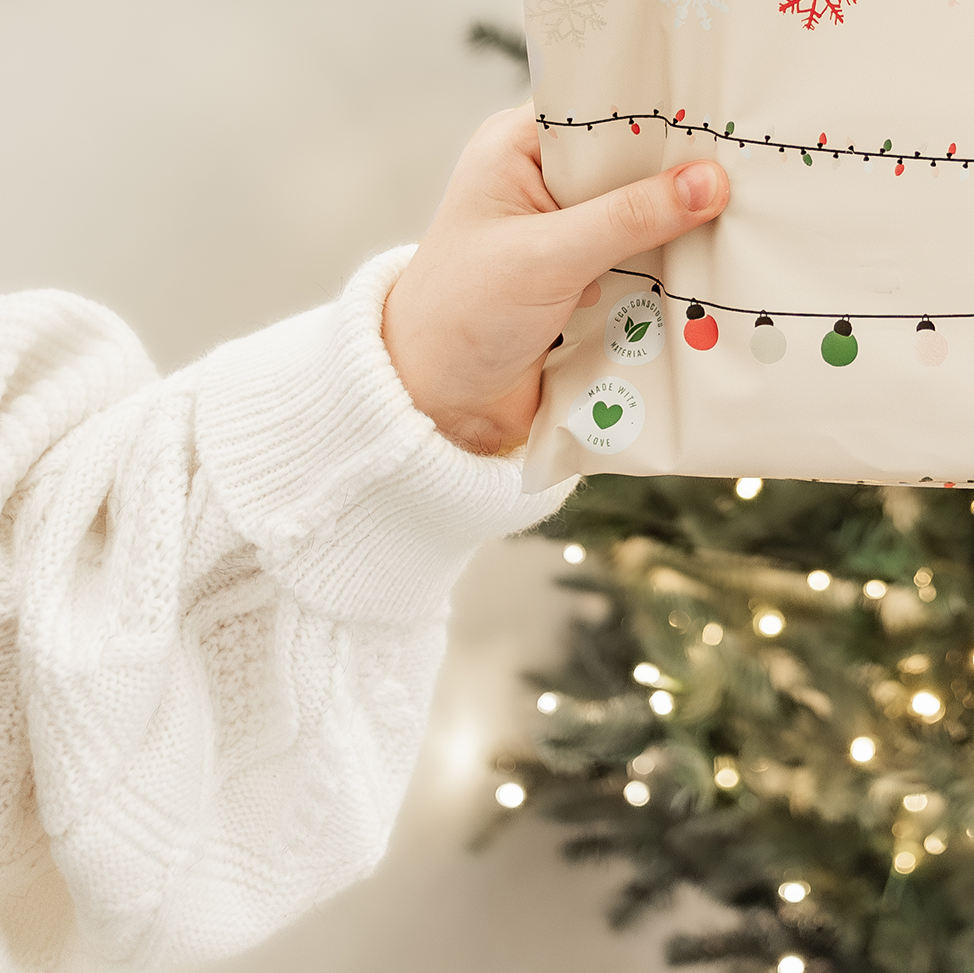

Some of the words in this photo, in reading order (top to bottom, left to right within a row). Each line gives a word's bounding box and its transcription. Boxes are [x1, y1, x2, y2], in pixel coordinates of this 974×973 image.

[614, 299, 663, 328] ECO-CONSCIOUS
[610, 340, 647, 358] MATERIAL
[588, 382, 613, 397] MADE
[617, 386, 637, 408] WITH
[587, 434, 610, 447] LOVE
